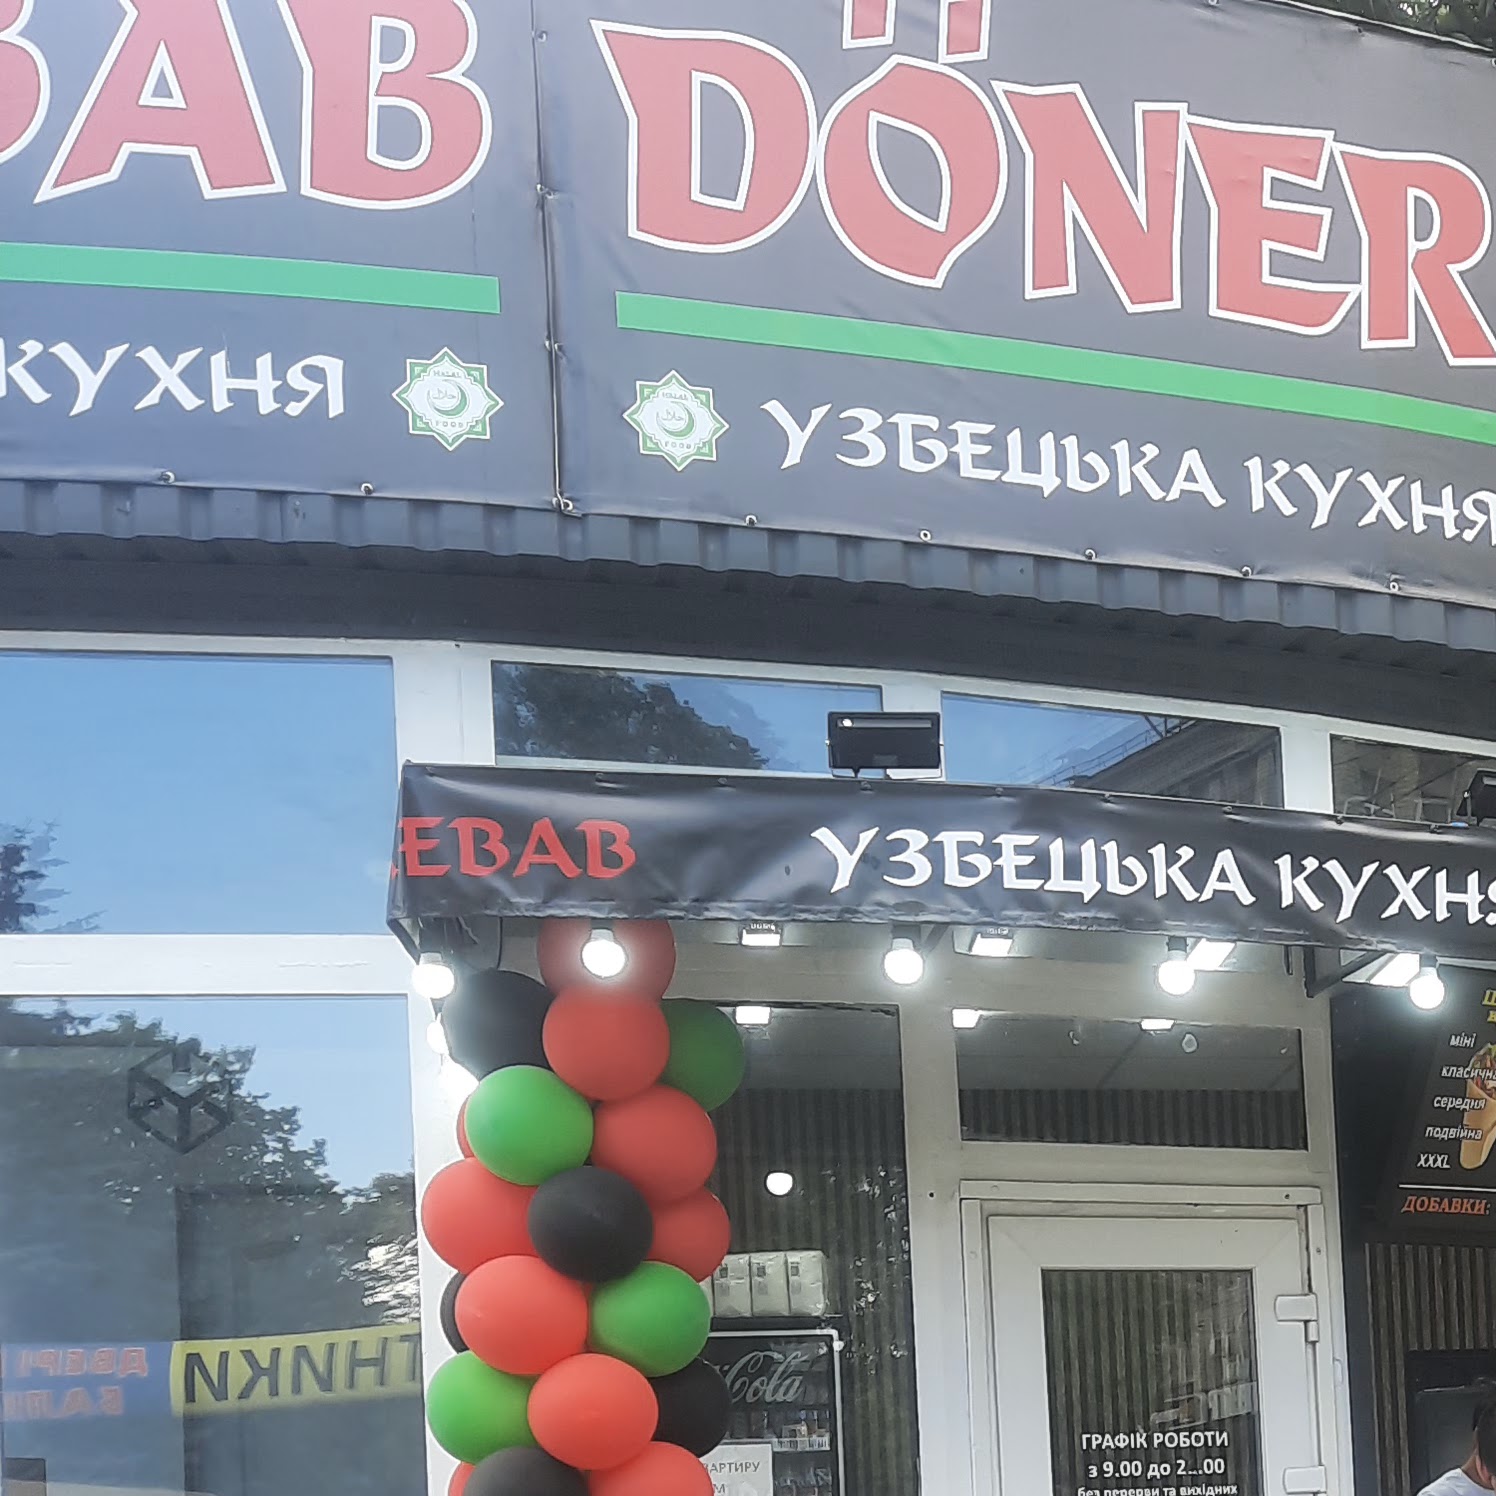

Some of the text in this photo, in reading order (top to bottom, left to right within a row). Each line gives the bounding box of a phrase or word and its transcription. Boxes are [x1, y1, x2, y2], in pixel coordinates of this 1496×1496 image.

[0, 0, 493, 210] AB
[0, 339, 345, 418] КУХНЯ
[760, 399, 1226, 510] УЗБЕЦЬКА
[392, 816, 637, 879] EBAB
[810, 826, 1257, 906] УЗБЕЦЬКА
[1450, 1033, 1477, 1048] міні
[1433, 1094, 1486, 1110] середня
[1425, 1125, 1483, 1143] подвійна
[1417, 1153, 1451, 1170] XXXL
[1401, 1195, 1491, 1215] ДОБАВКИ:
[1081, 1430, 1229, 1450] ГРАФІК РОБОТИ
[1102, 1460, 1143, 1478] 9.00
[1147, 1462, 1171, 1480] до
[1176, 1457, 1226, 1476] 2.00
[1163, 1486, 1176, 1496] та
